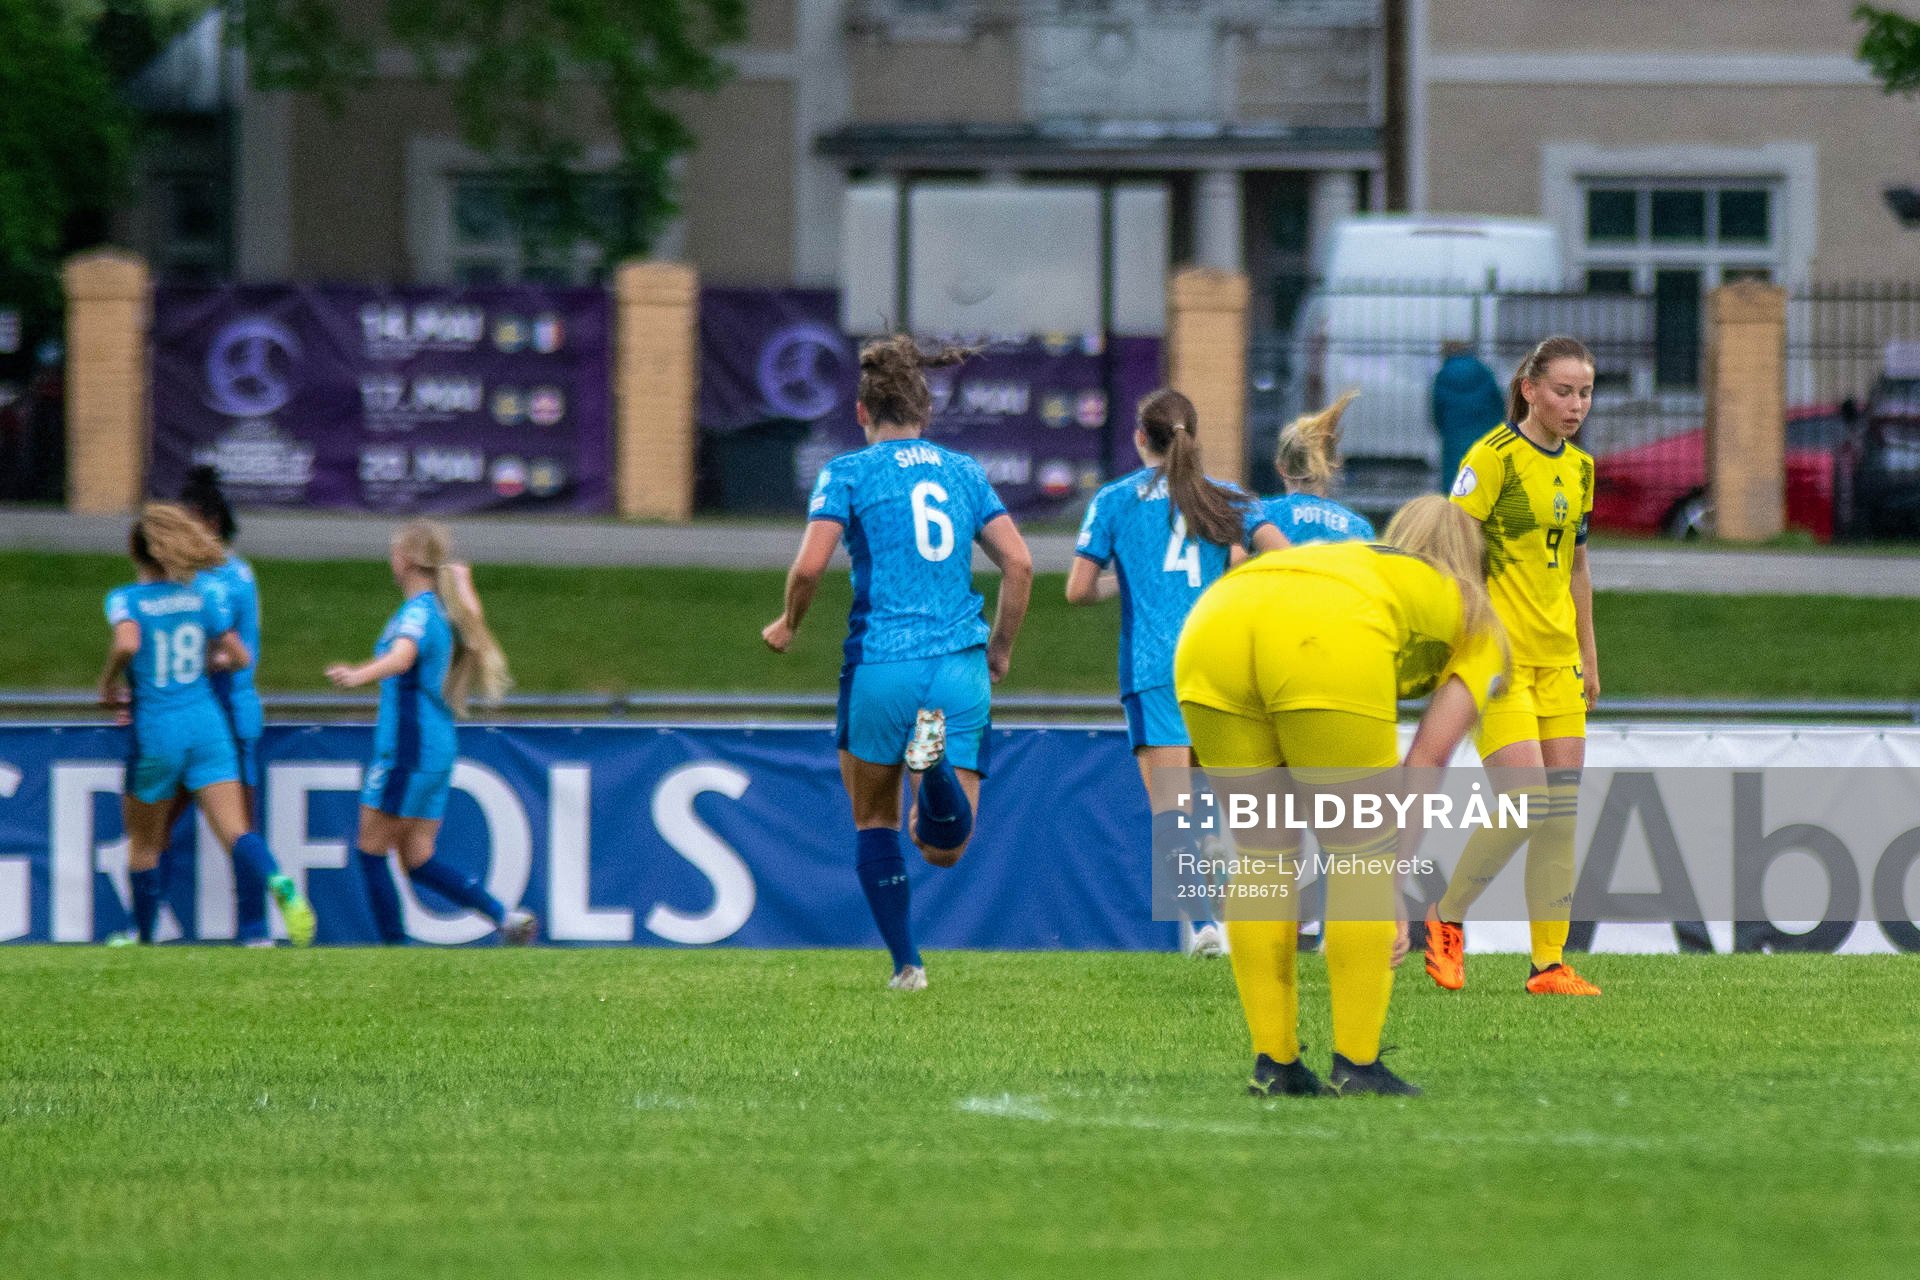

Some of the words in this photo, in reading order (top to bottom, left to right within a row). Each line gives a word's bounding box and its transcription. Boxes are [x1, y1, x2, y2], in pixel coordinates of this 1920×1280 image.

[893, 445, 942, 469] SHAW
[910, 477, 955, 563] 6
[1292, 504, 1350, 534] POTTER
[1162, 512, 1202, 588] 4
[1545, 527, 1564, 569] 9
[154, 623, 205, 688] 18
